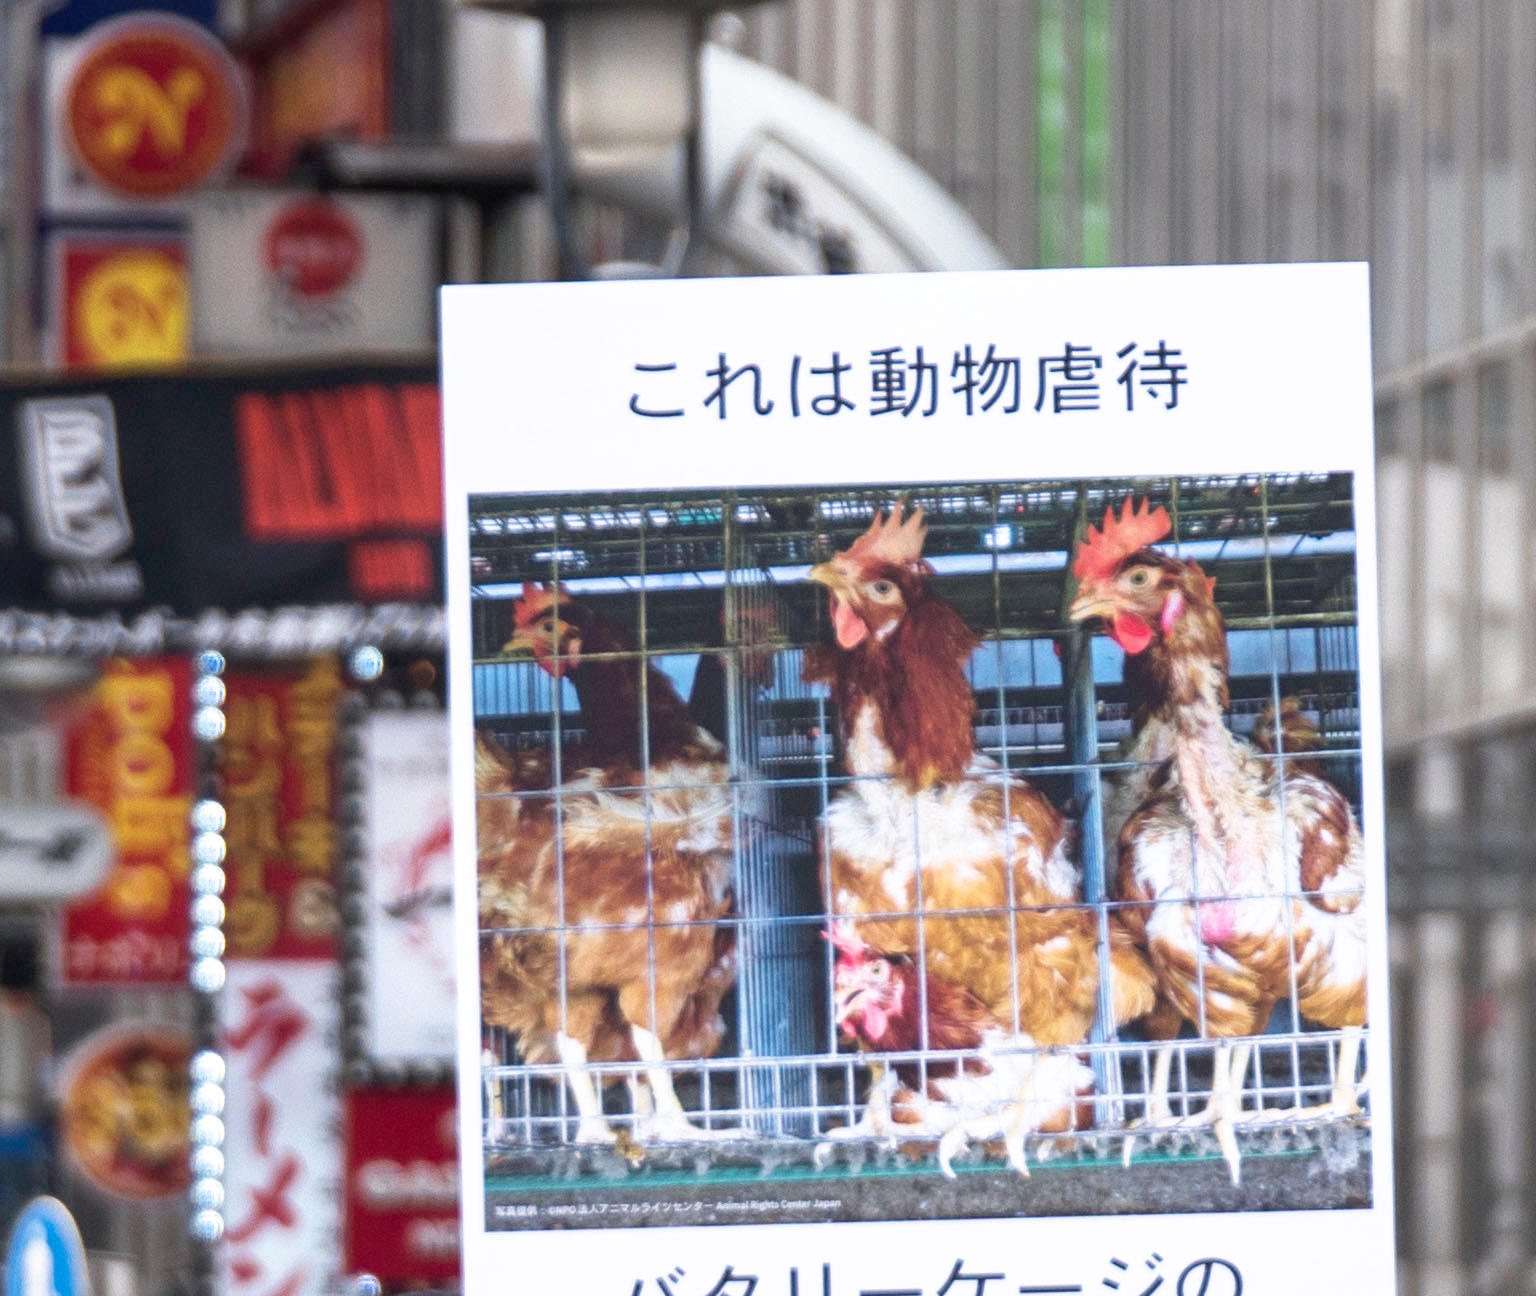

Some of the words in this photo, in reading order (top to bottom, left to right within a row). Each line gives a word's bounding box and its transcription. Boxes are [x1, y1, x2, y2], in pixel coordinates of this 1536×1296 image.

[629, 340, 1188, 420] これは動物虐待
[813, 1198, 842, 1209] Japan
